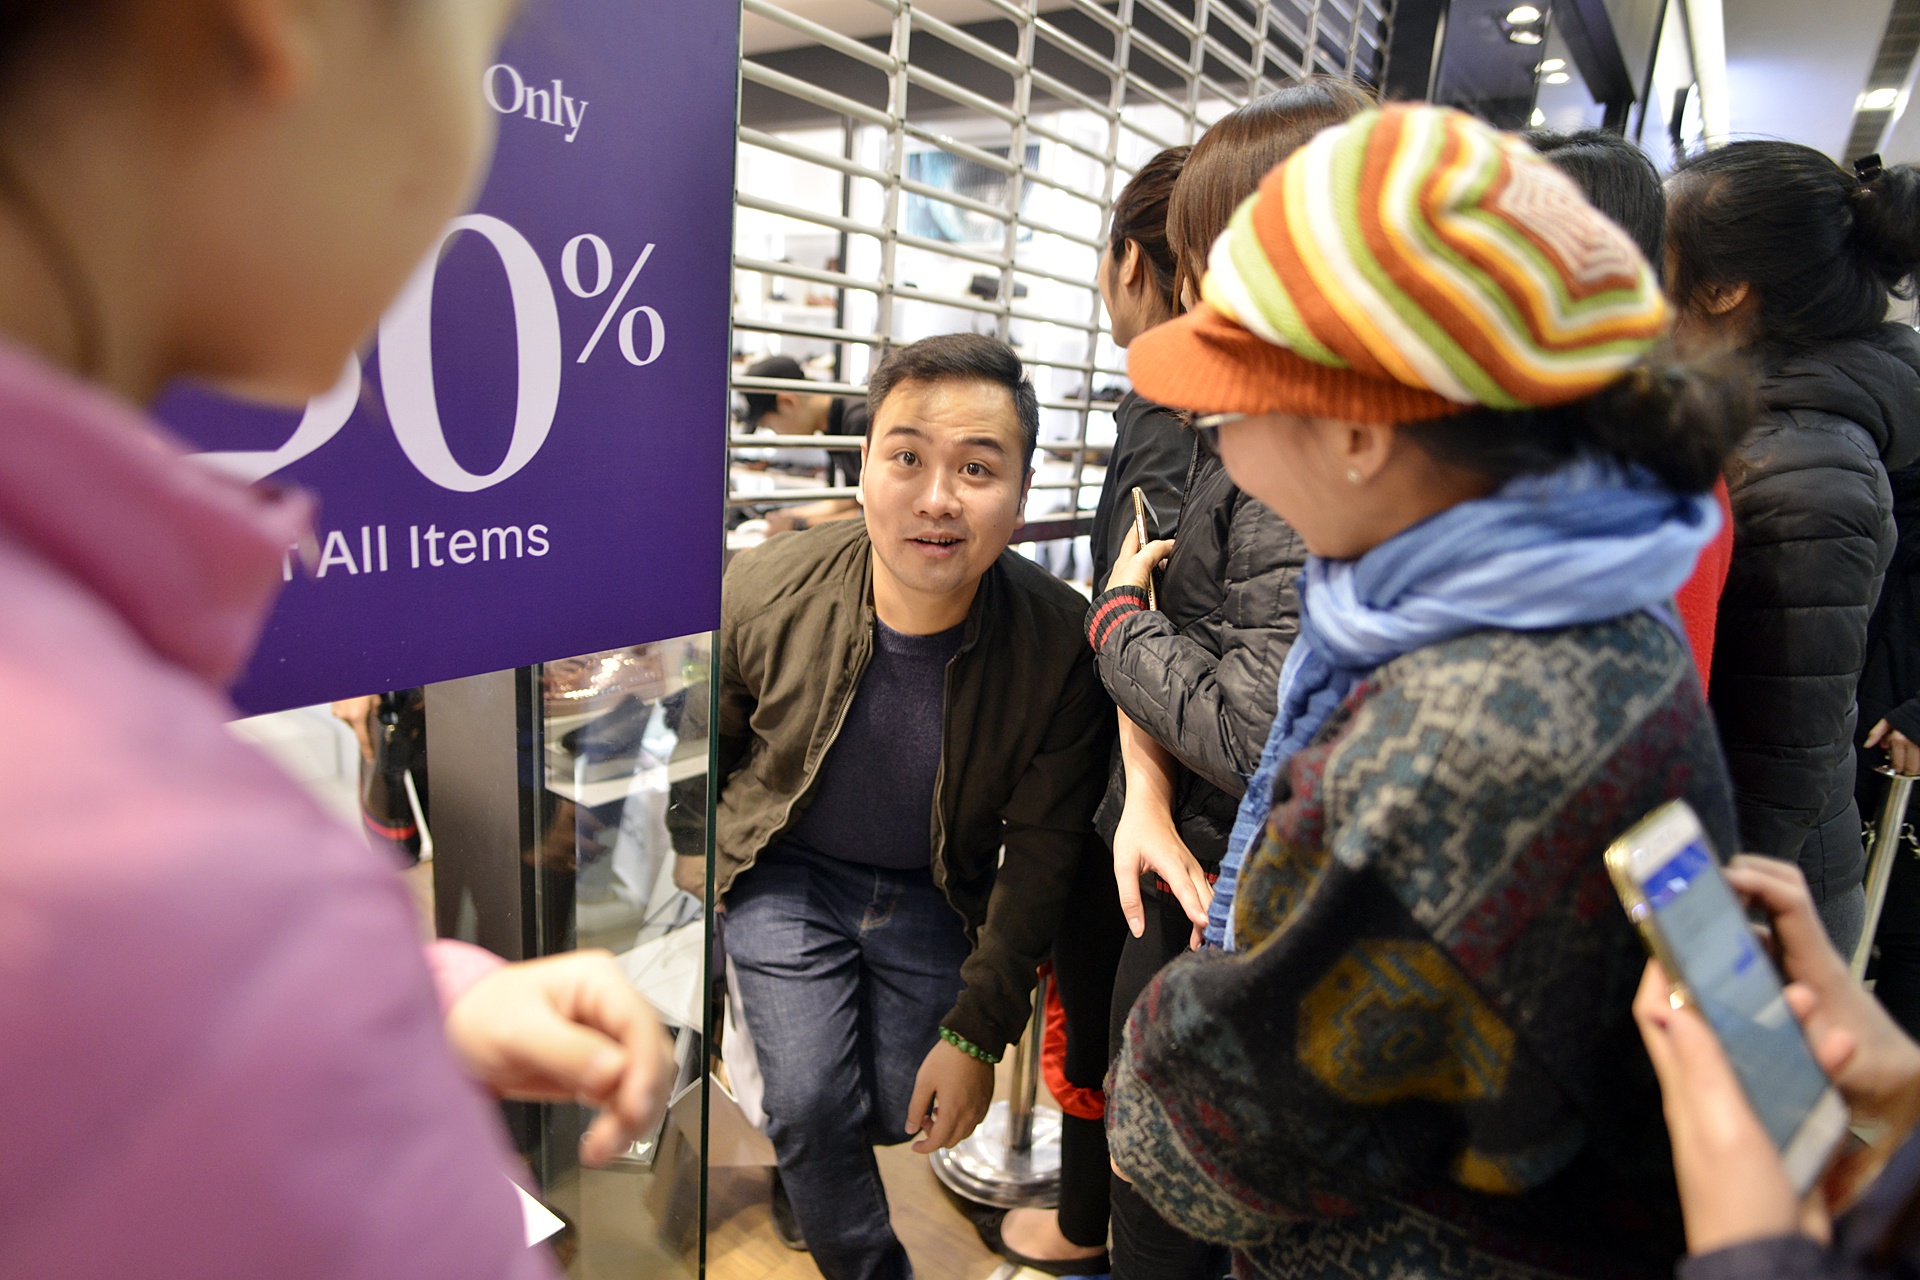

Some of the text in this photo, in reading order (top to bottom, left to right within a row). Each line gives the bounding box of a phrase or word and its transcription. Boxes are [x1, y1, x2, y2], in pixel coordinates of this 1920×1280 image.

[482, 63, 589, 143] Only
[316, 524, 388, 578] All
[409, 523, 550, 569] Items
